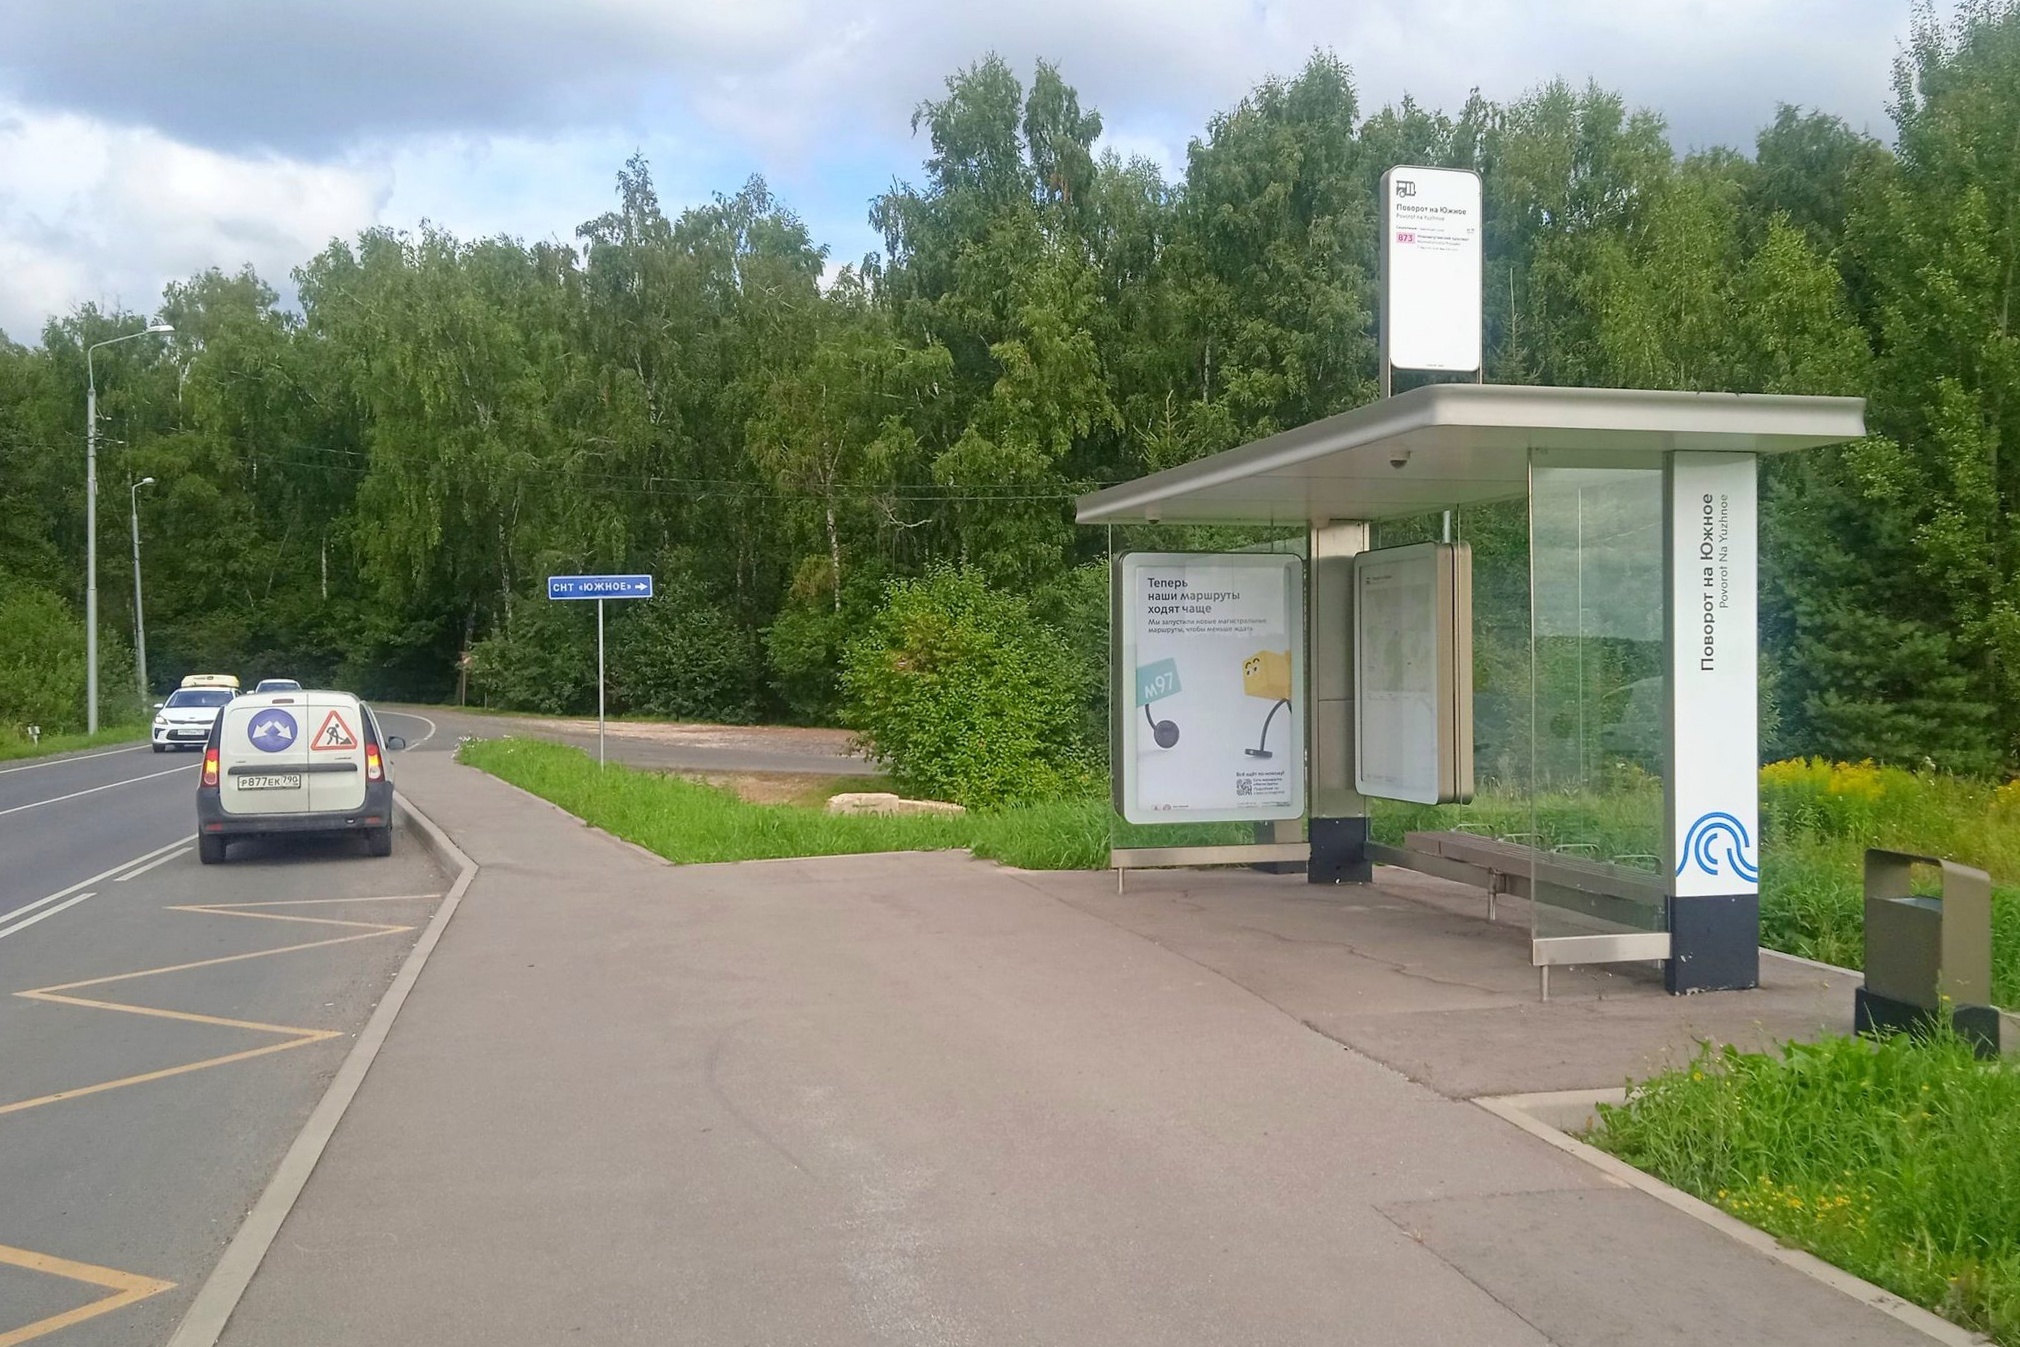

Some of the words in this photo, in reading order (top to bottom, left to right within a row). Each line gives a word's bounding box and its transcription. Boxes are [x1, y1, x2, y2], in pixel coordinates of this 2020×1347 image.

[1396, 203, 1428, 213] Поворот
[1440, 206, 1467, 215] Южное
[1700, 493, 1714, 561] Южное
[1718, 494, 1729, 543] Yuzhnoe
[1719, 546, 1729, 563] Na
[1147, 577, 1189, 589] Теперь
[1703, 566, 1714, 587] на
[552, 583, 574, 592] СНТ
[578, 582, 632, 592] «ЮЖНОЕ»
[1719, 565, 1729, 609] Povorot
[1148, 592, 1178, 601] наши
[1180, 591, 1241, 602] маршруты
[1148, 604, 1180, 615] ходят
[1182, 603, 1212, 614] чаще
[1701, 592, 1715, 671] Поворот
